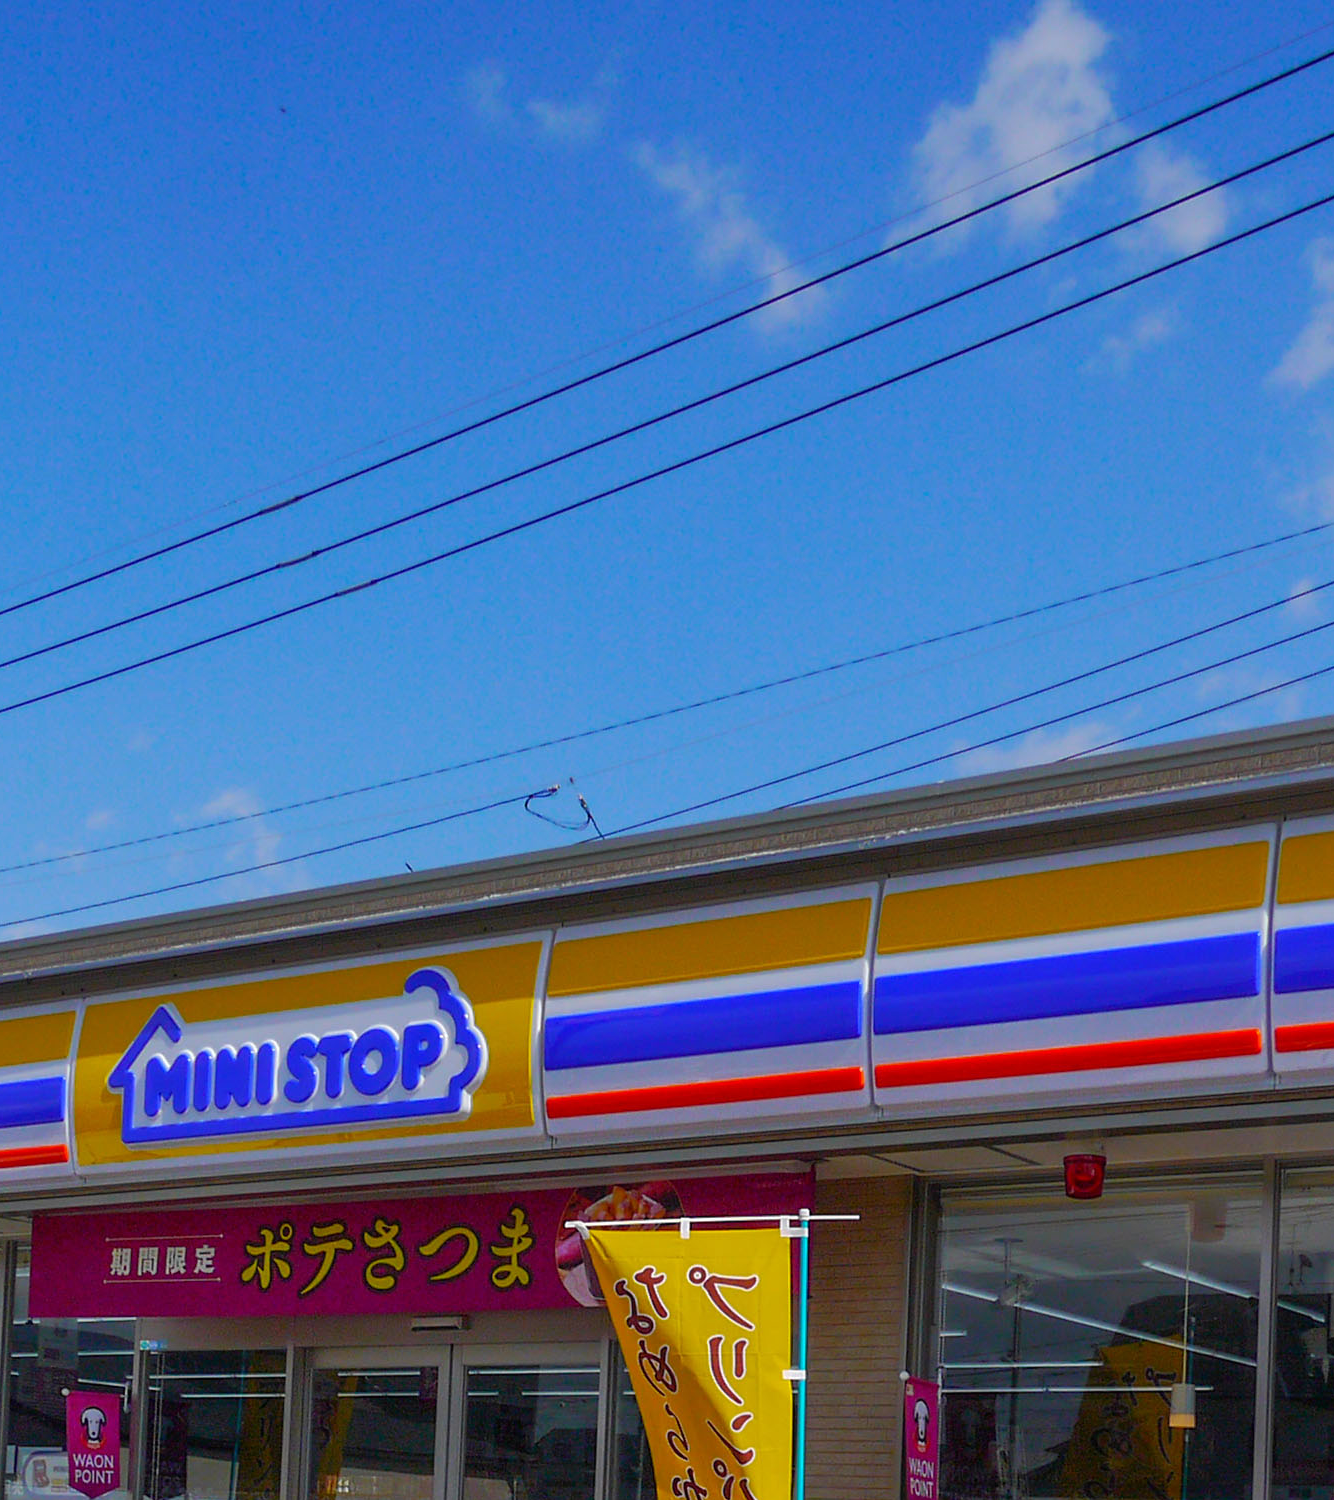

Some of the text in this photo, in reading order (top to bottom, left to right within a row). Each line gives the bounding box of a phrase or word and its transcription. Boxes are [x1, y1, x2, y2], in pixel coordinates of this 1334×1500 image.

[143, 1020, 447, 1118] MINI STOP
[109, 1244, 217, 1276] 期間限定
[241, 1206, 534, 1296] ポテさつま
[73, 1453, 115, 1469] WAON
[908, 1457, 935, 1479] WAON
[74, 1469, 115, 1485] POINT
[910, 1478, 934, 1499] POINT
